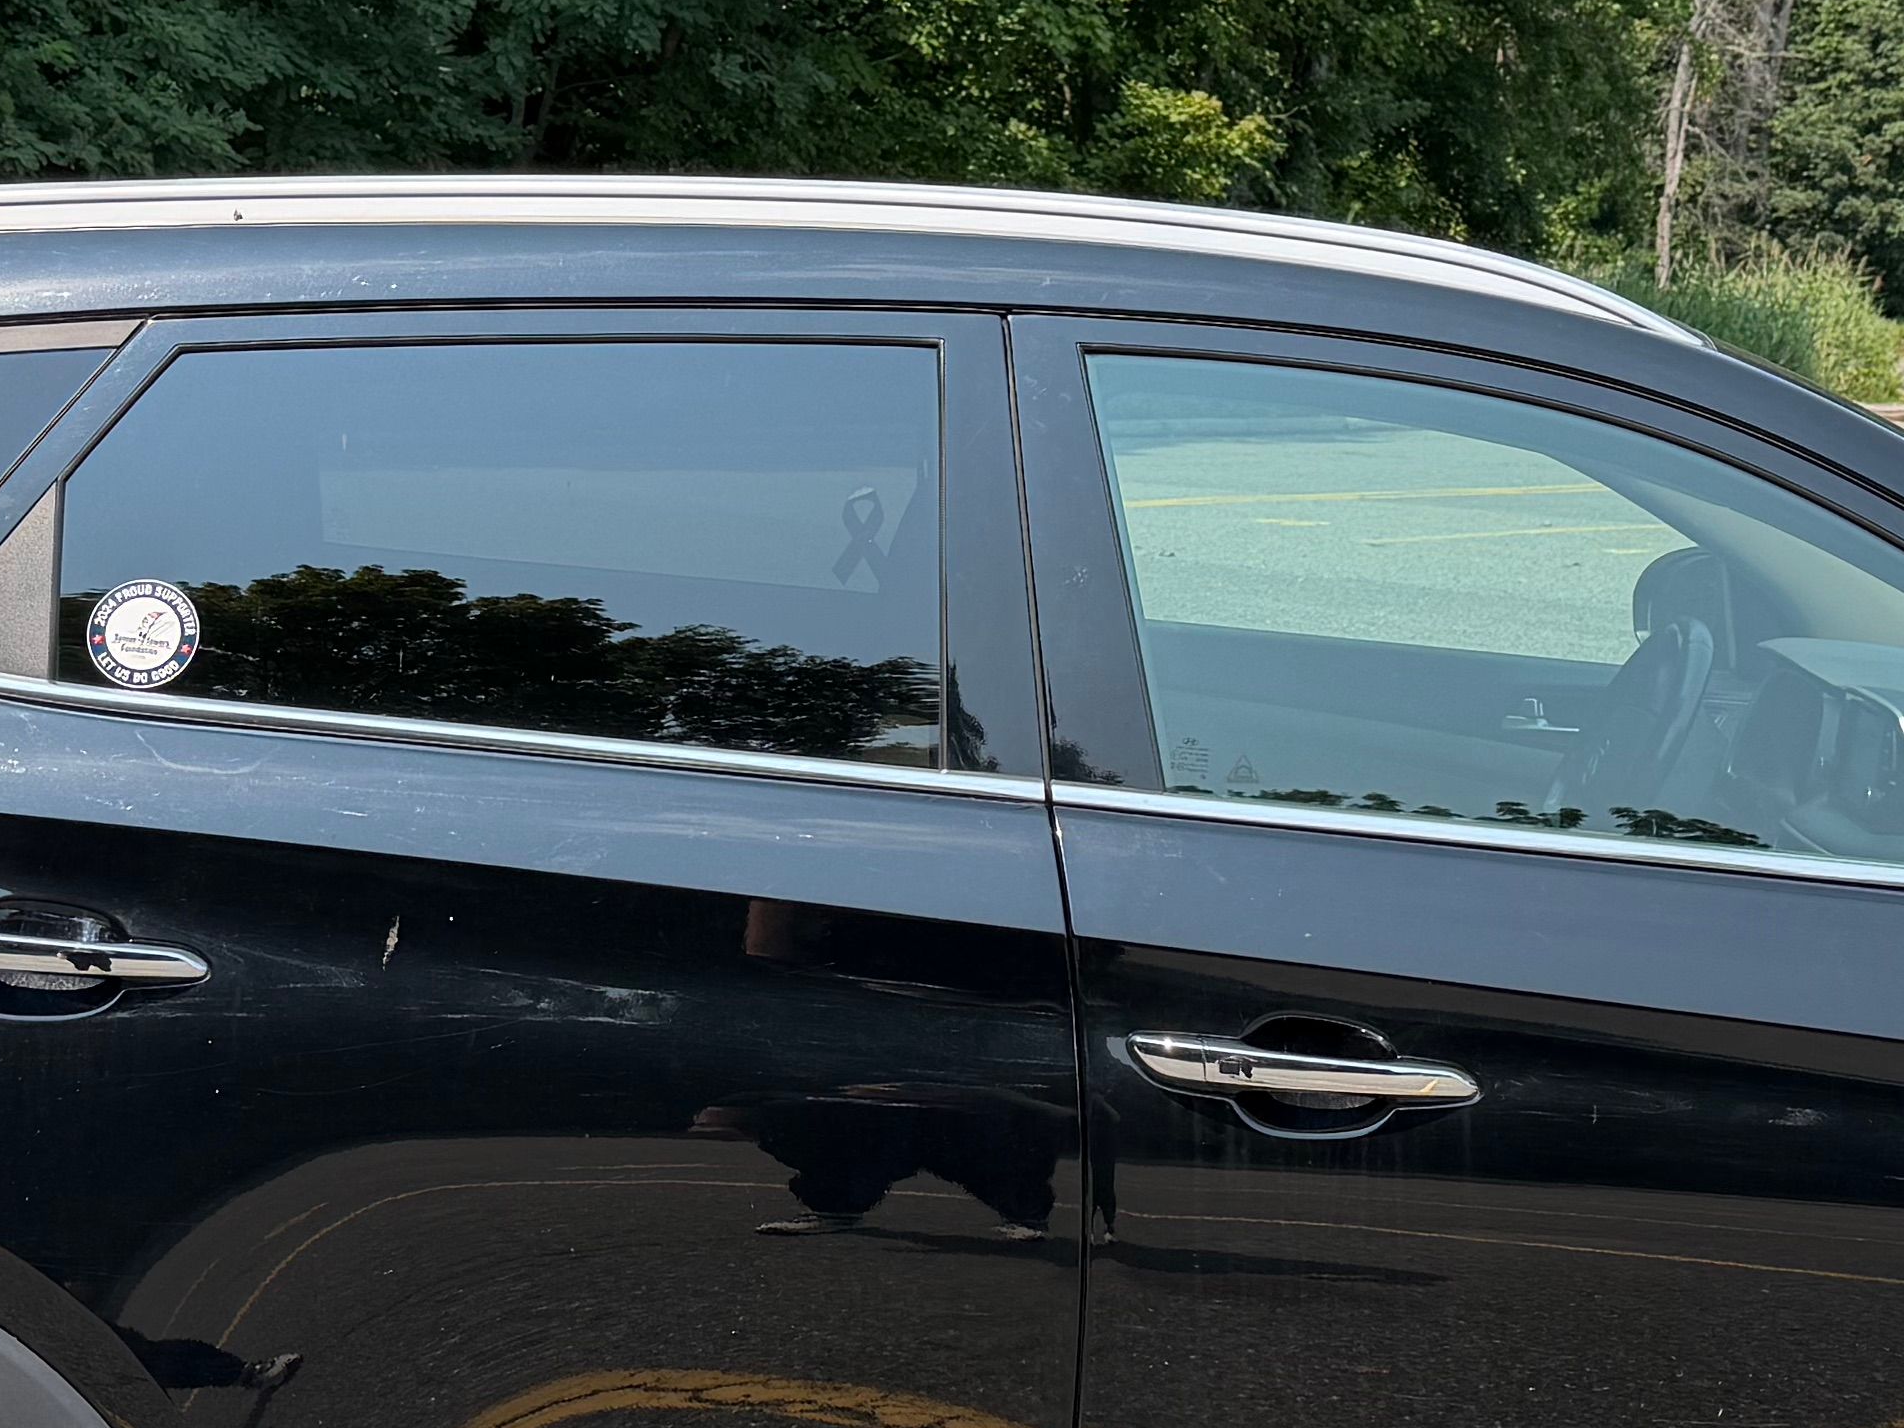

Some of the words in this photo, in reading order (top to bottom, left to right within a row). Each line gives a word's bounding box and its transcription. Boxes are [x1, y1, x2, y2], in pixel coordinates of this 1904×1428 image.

[94, 598, 116, 627] 2024
[114, 584, 153, 603] PROUD
[154, 586, 197, 637] SUPPORTER
[98, 652, 116, 671] LET
[114, 667, 130, 681] US
[133, 672, 148, 683] DO
[151, 660, 180, 681] GOOD
